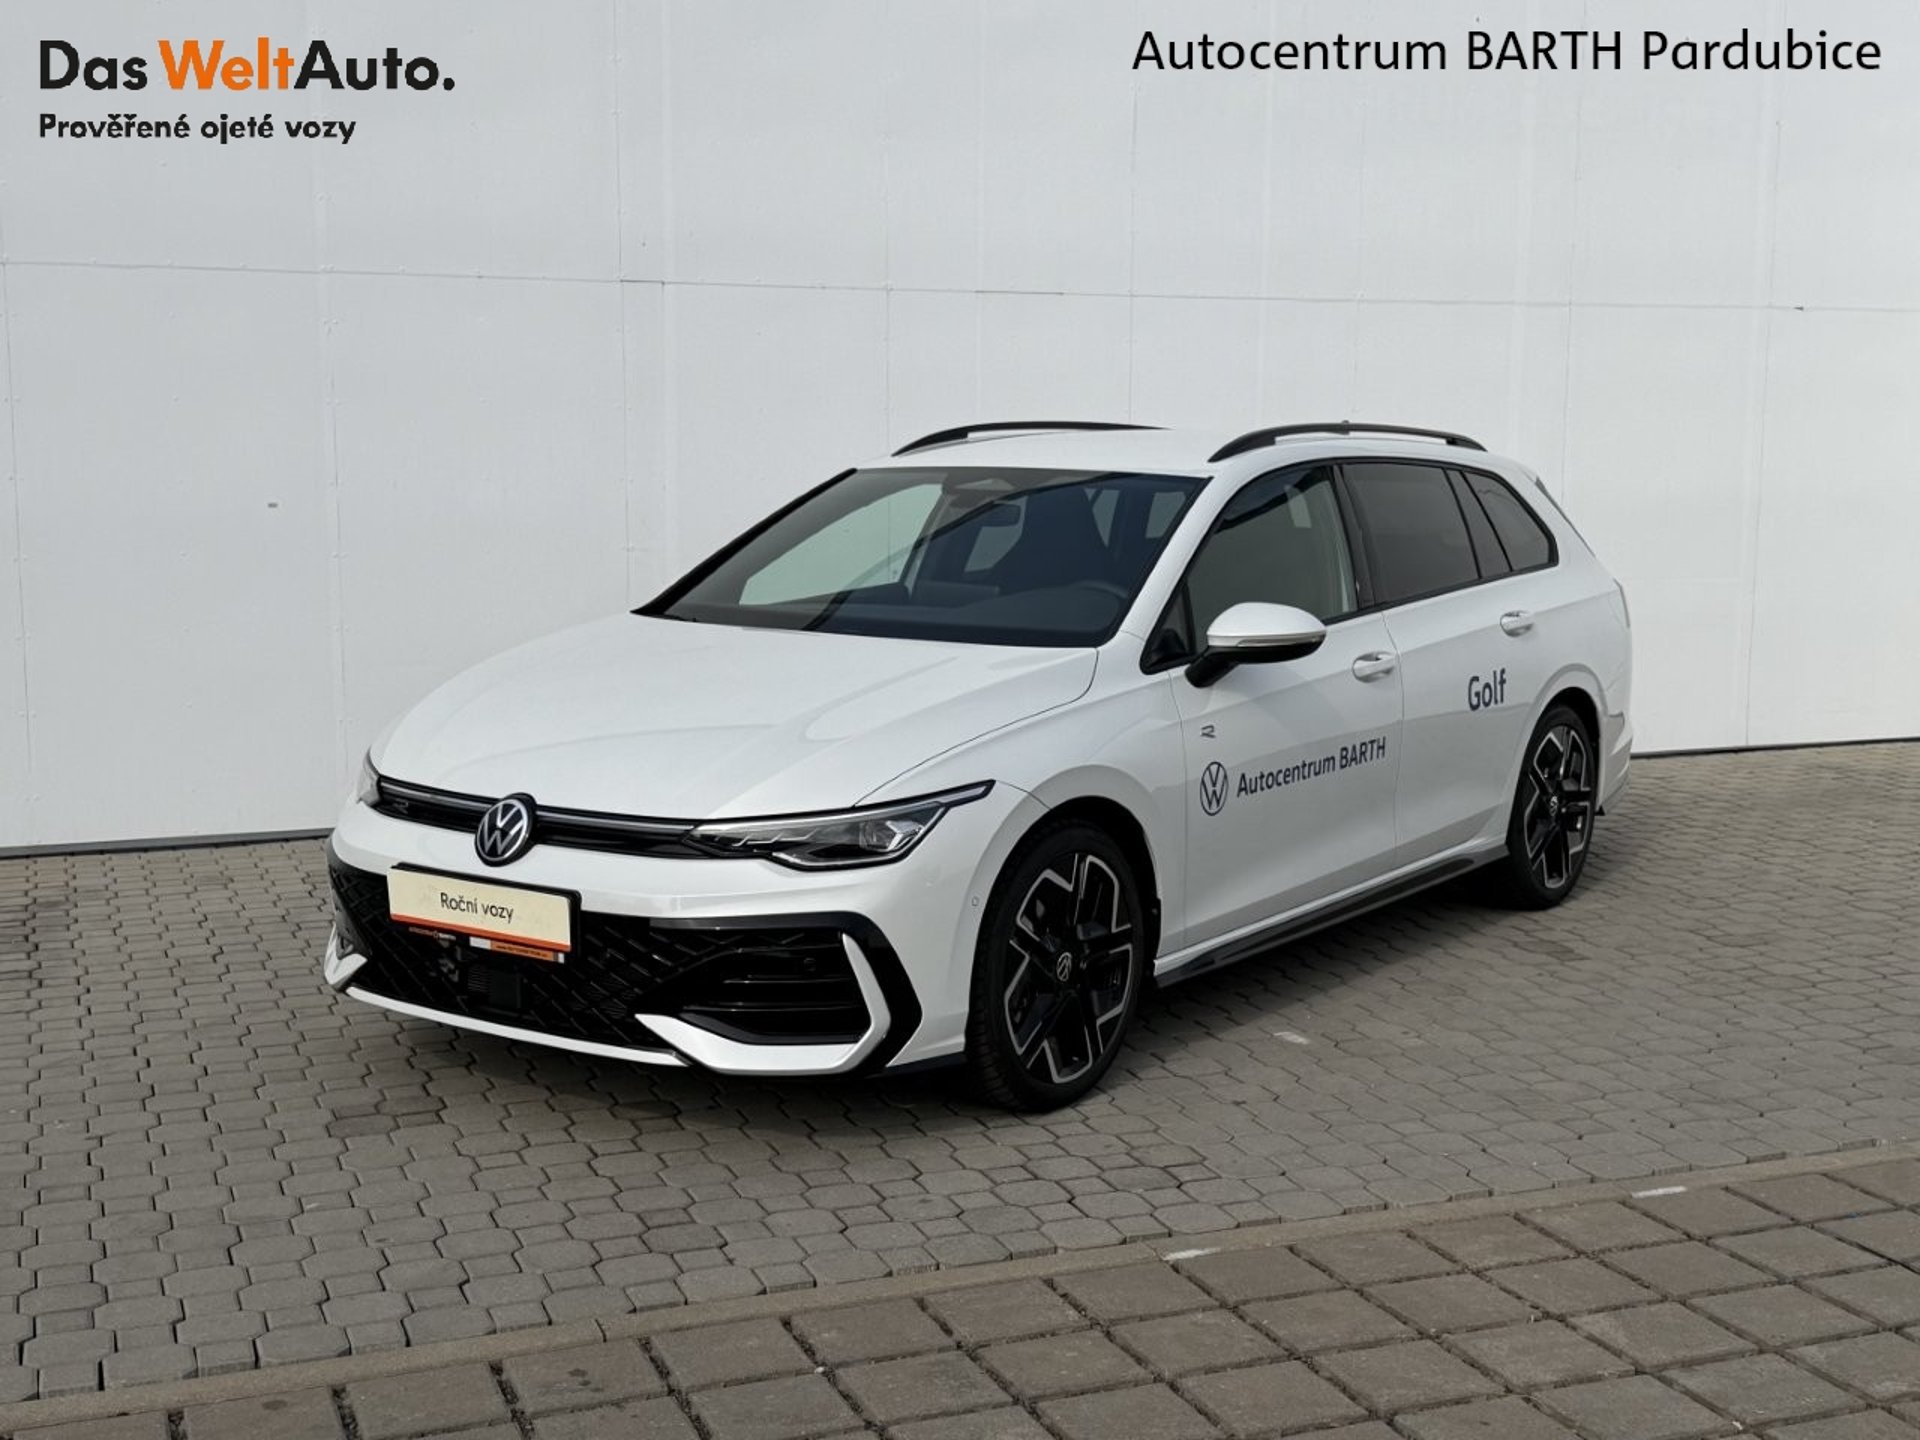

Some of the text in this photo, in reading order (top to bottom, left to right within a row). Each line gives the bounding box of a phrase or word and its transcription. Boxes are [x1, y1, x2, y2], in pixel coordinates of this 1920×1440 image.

[1468, 668, 1506, 711] Golf
[1237, 736, 1386, 798] Autocentrum BARTH
[440, 892, 514, 924] Roční vozy
